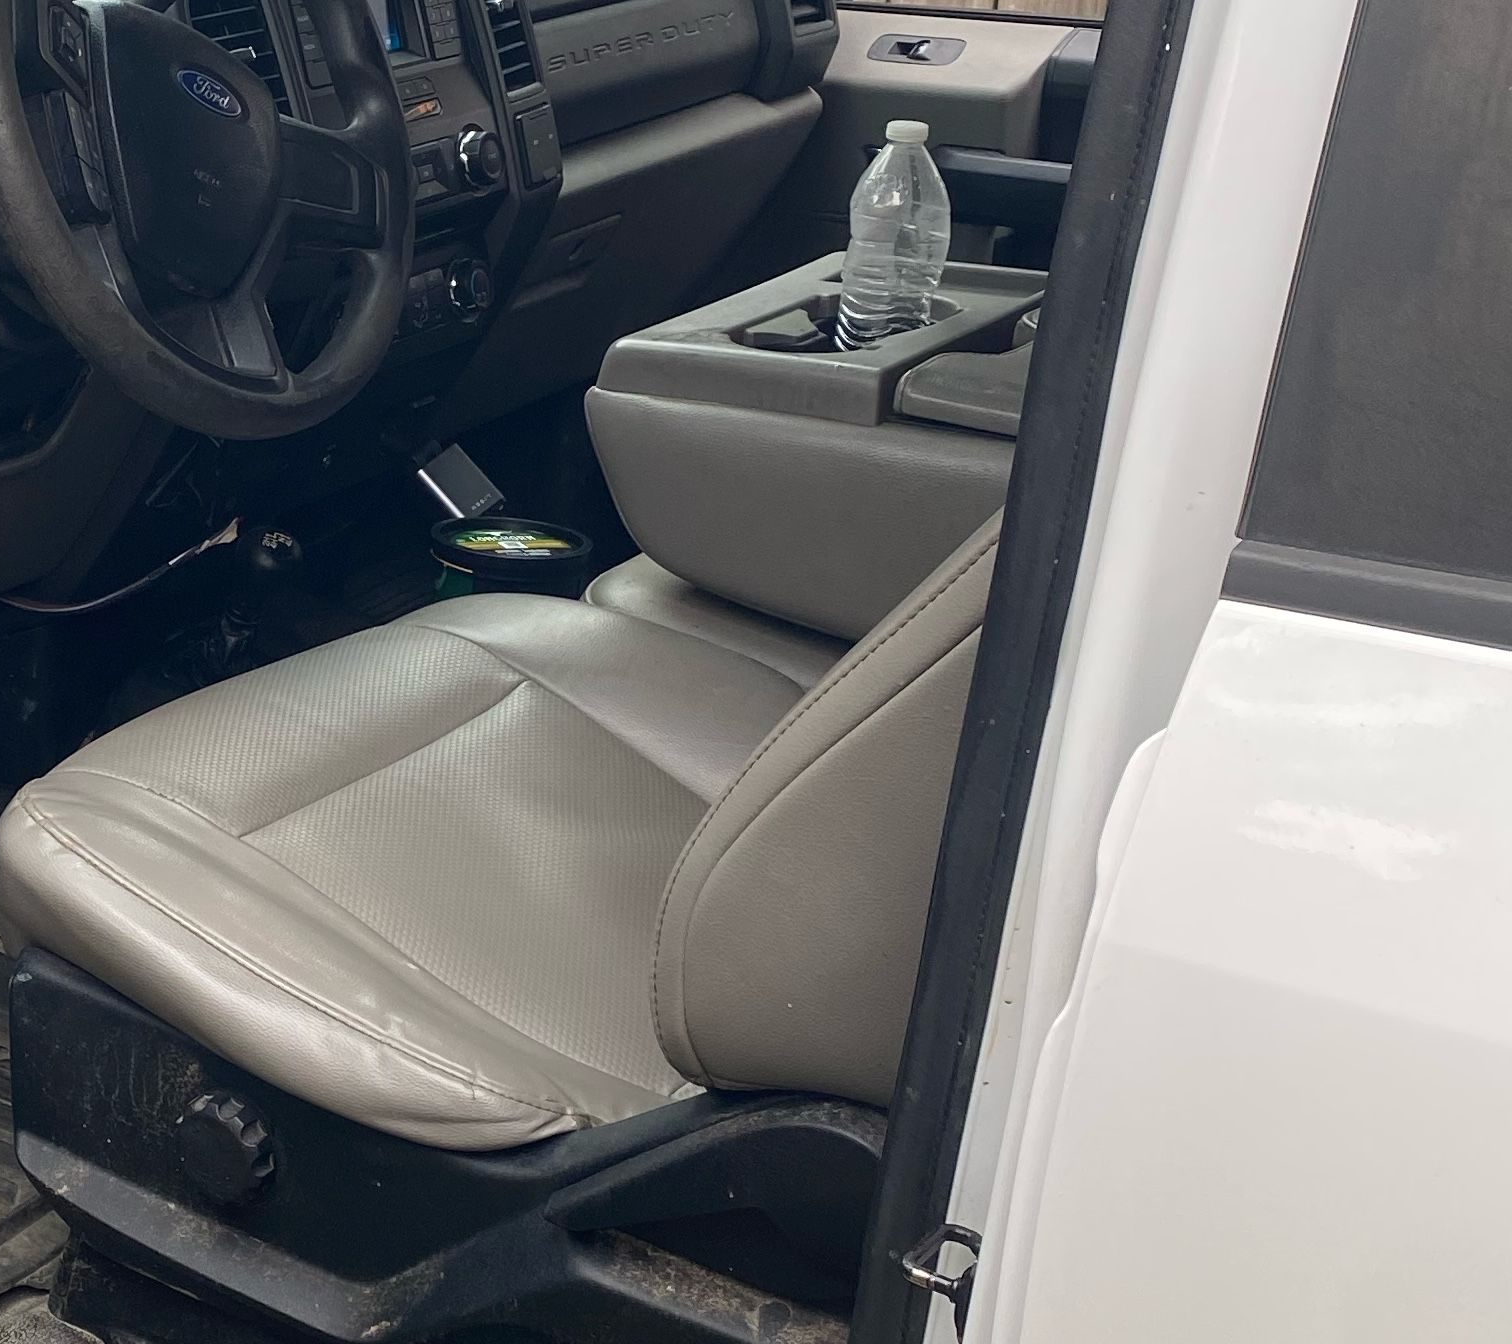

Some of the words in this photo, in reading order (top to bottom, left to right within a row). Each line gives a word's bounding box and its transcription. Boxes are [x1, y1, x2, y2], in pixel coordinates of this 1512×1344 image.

[547, 31, 655, 73] SUPER
[660, 10, 734, 43] DUTY
[193, 76, 230, 109] Ford
